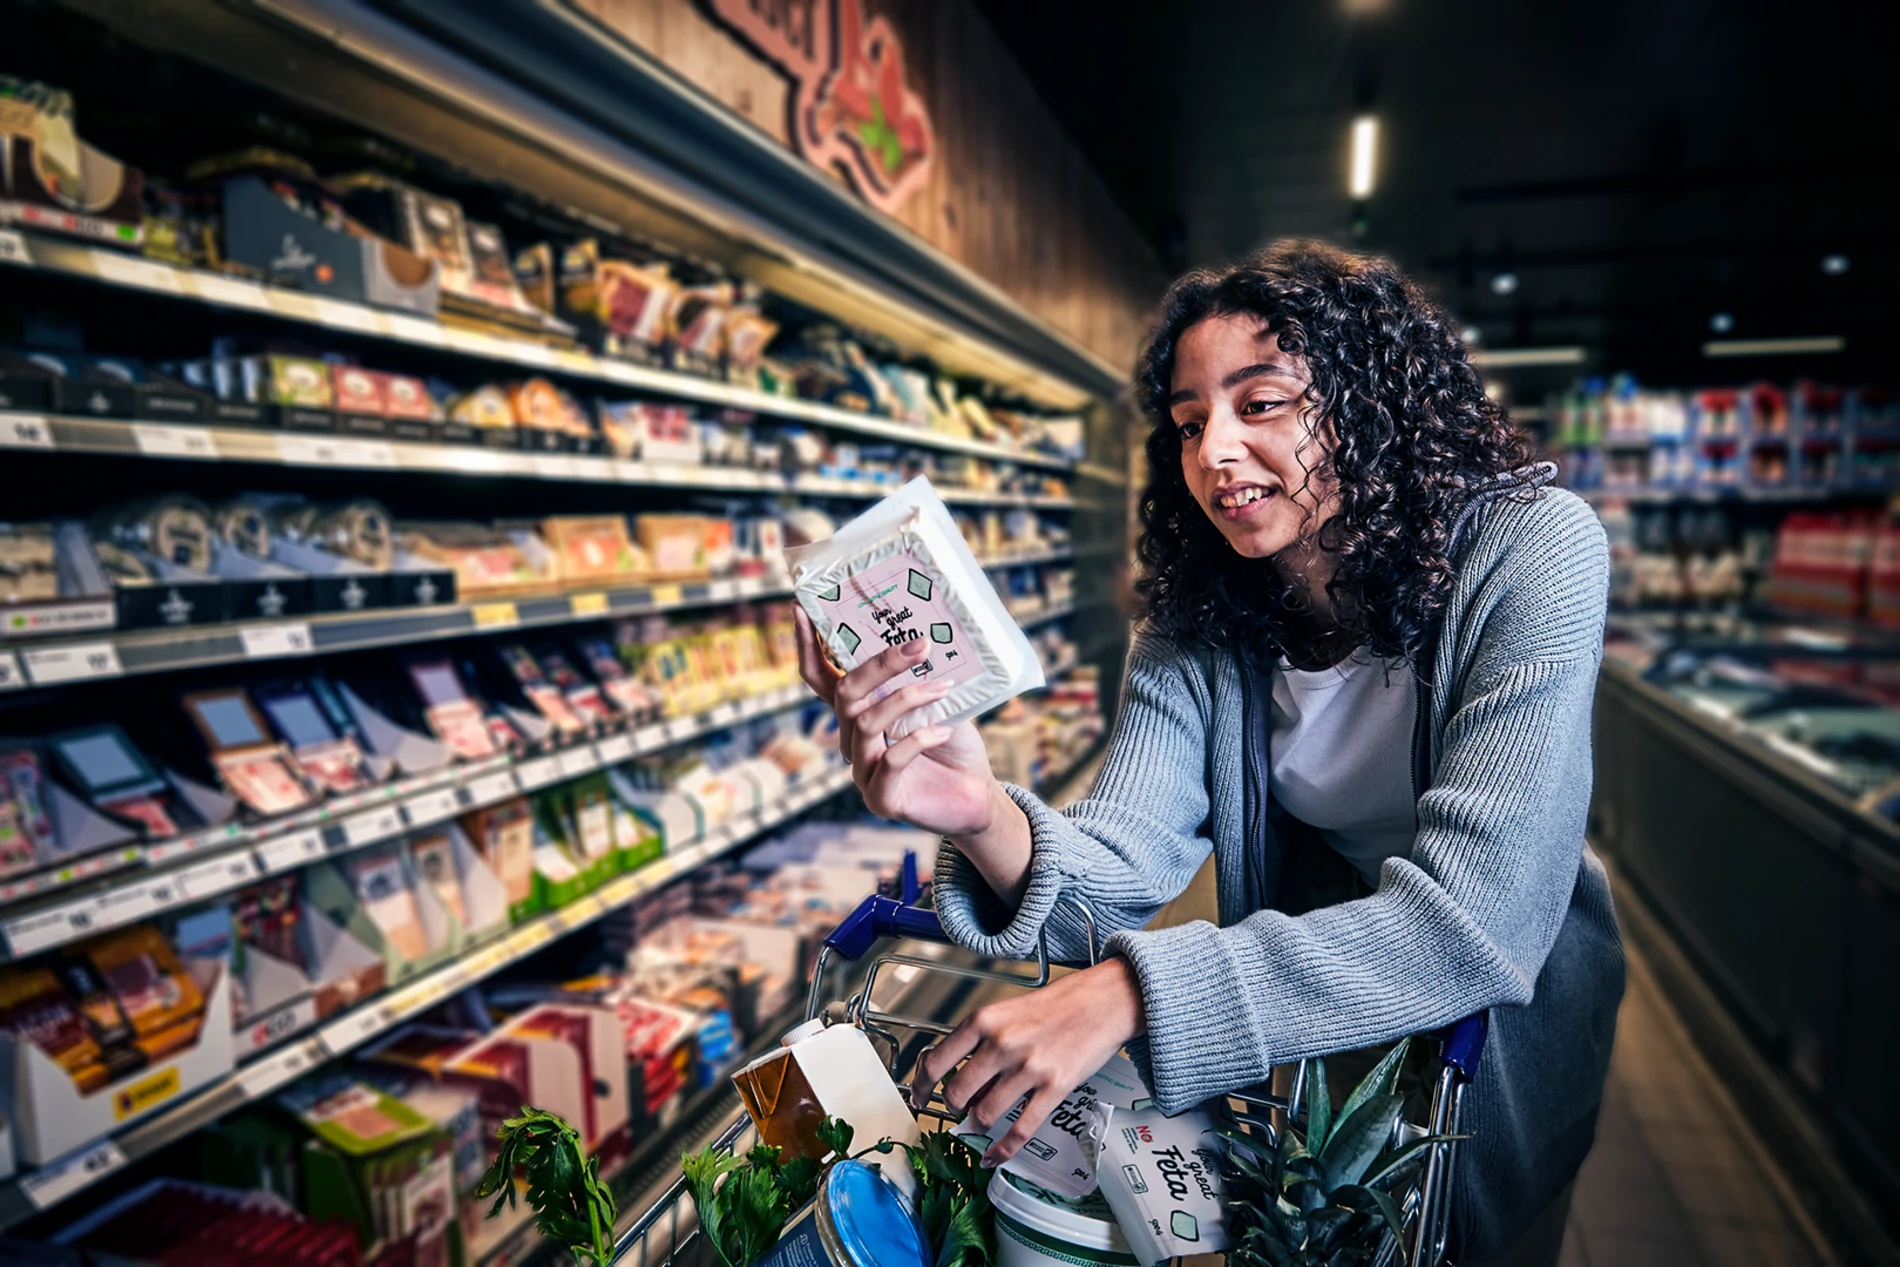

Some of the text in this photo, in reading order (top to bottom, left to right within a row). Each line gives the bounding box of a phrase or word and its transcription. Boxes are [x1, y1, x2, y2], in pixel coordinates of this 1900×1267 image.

[886, 606, 913, 630] great
[1135, 1125, 1153, 1143] NO
[1151, 1144, 1188, 1201] Feta
[1183, 1161, 1219, 1200] great
